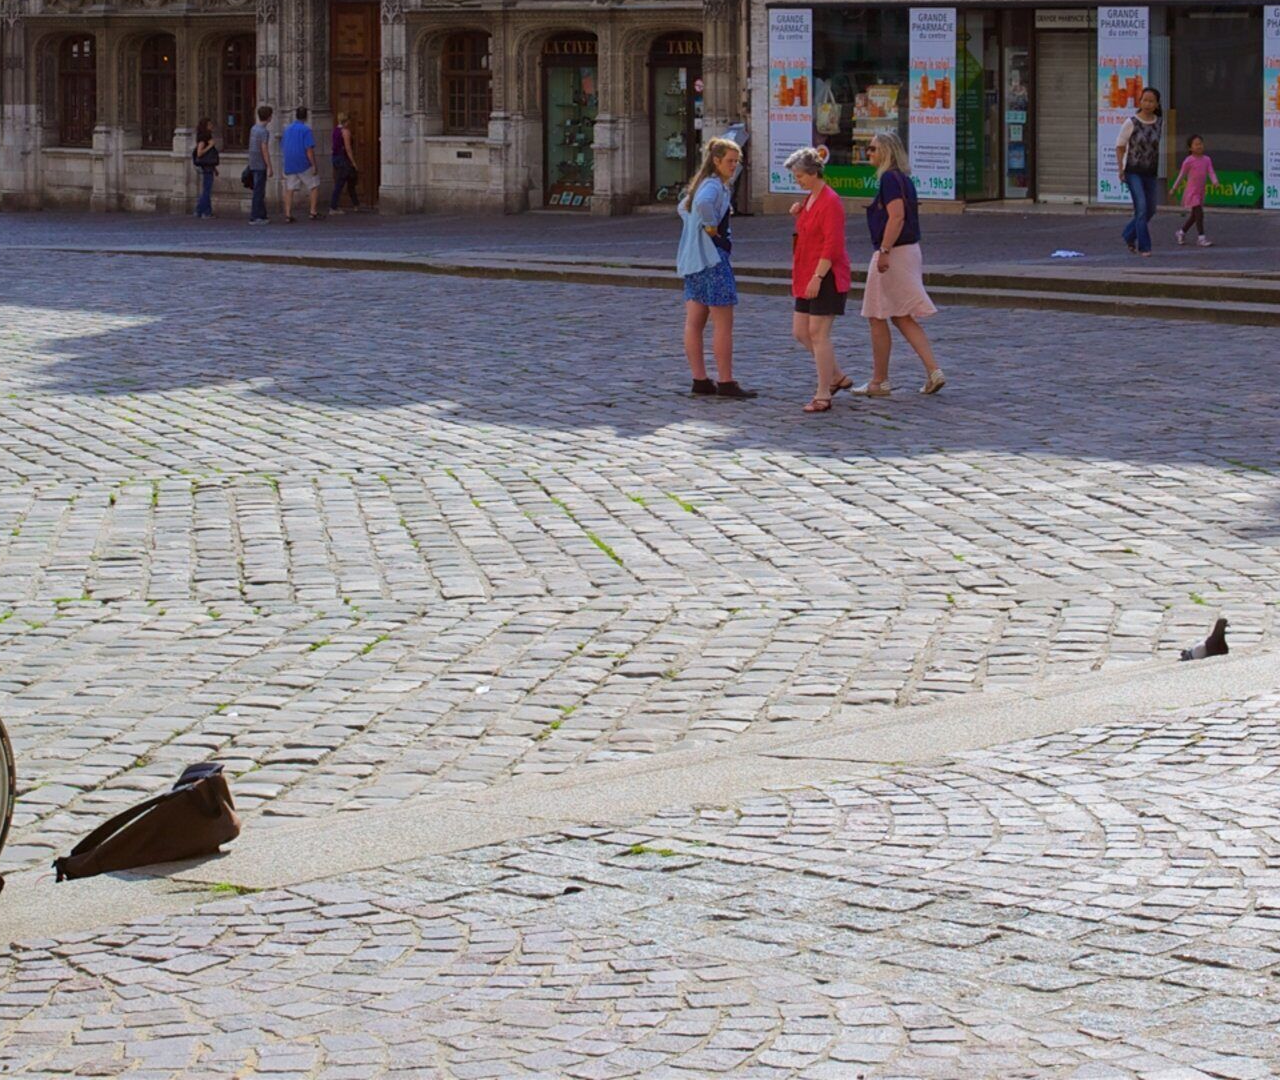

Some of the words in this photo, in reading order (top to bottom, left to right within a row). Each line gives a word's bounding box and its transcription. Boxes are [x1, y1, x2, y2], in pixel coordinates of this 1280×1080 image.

[918, 13, 948, 22] GRANDE
[1107, 9, 1139, 18] GRANDE
[1100, 19, 1146, 29] PHARMACIE
[929, 176, 953, 189] 19h30
[1266, 185, 1278, 198] 9h
